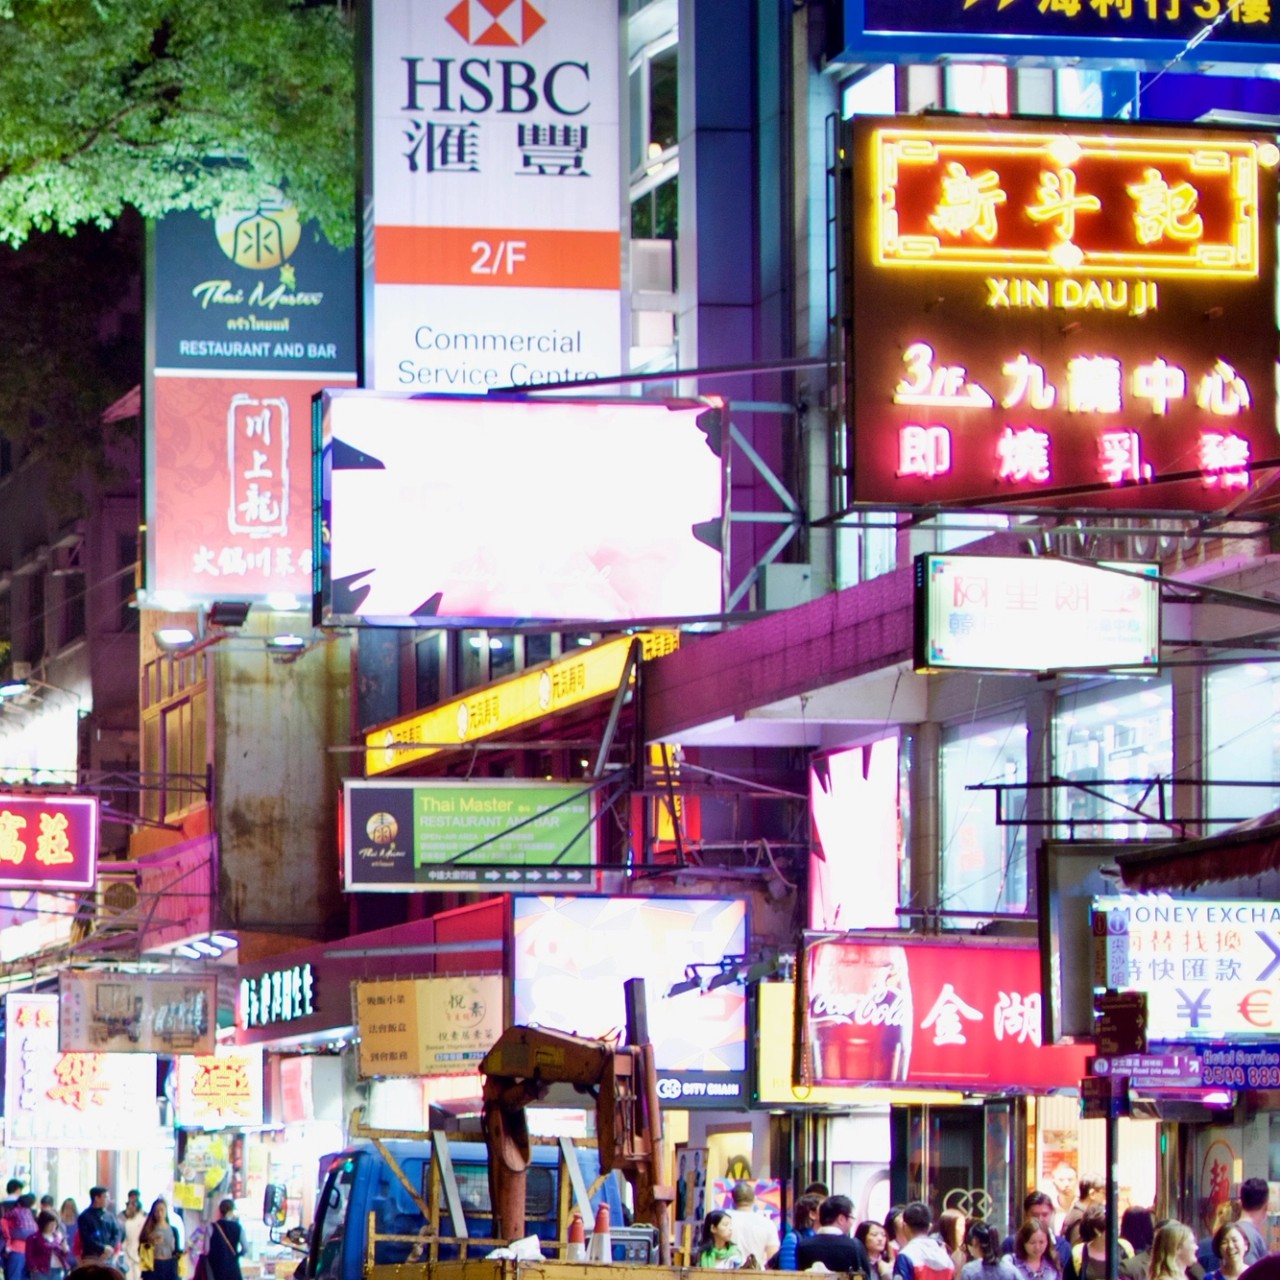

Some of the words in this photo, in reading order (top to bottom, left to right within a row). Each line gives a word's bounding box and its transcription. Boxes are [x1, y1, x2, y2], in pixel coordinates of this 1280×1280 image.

[400, 56, 591, 116] HSBC
[929, 161, 1204, 245] 新斗記
[470, 240, 527, 275] 2/F
[192, 279, 244, 310] Thai
[249, 280, 323, 310] Master
[985, 277, 1049, 309] XIN
[1054, 279, 1128, 310] DAU
[1130, 281, 1158, 316] JI
[179, 339, 271, 358] RESTAURANT
[273, 342, 304, 358] AND
[307, 343, 338, 359] BAR
[414, 325, 581, 353] Commercial
[397, 360, 498, 385] Service
[896, 342, 967, 396] 3/F
[420, 797, 454, 812] Thai
[460, 798, 513, 813] Master
[420, 816, 502, 827] RESTAURANT
[535, 817, 560, 828] BAR
[1113, 906, 1198, 923] MONEY
[920, 984, 1042, 1047] 金湖
[1203, 1050, 1235, 1065] Hotel
[1236, 1050, 1279, 1065] Service
[682, 1083, 706, 1095] CITY
[707, 1083, 739, 1095] CHAIN
